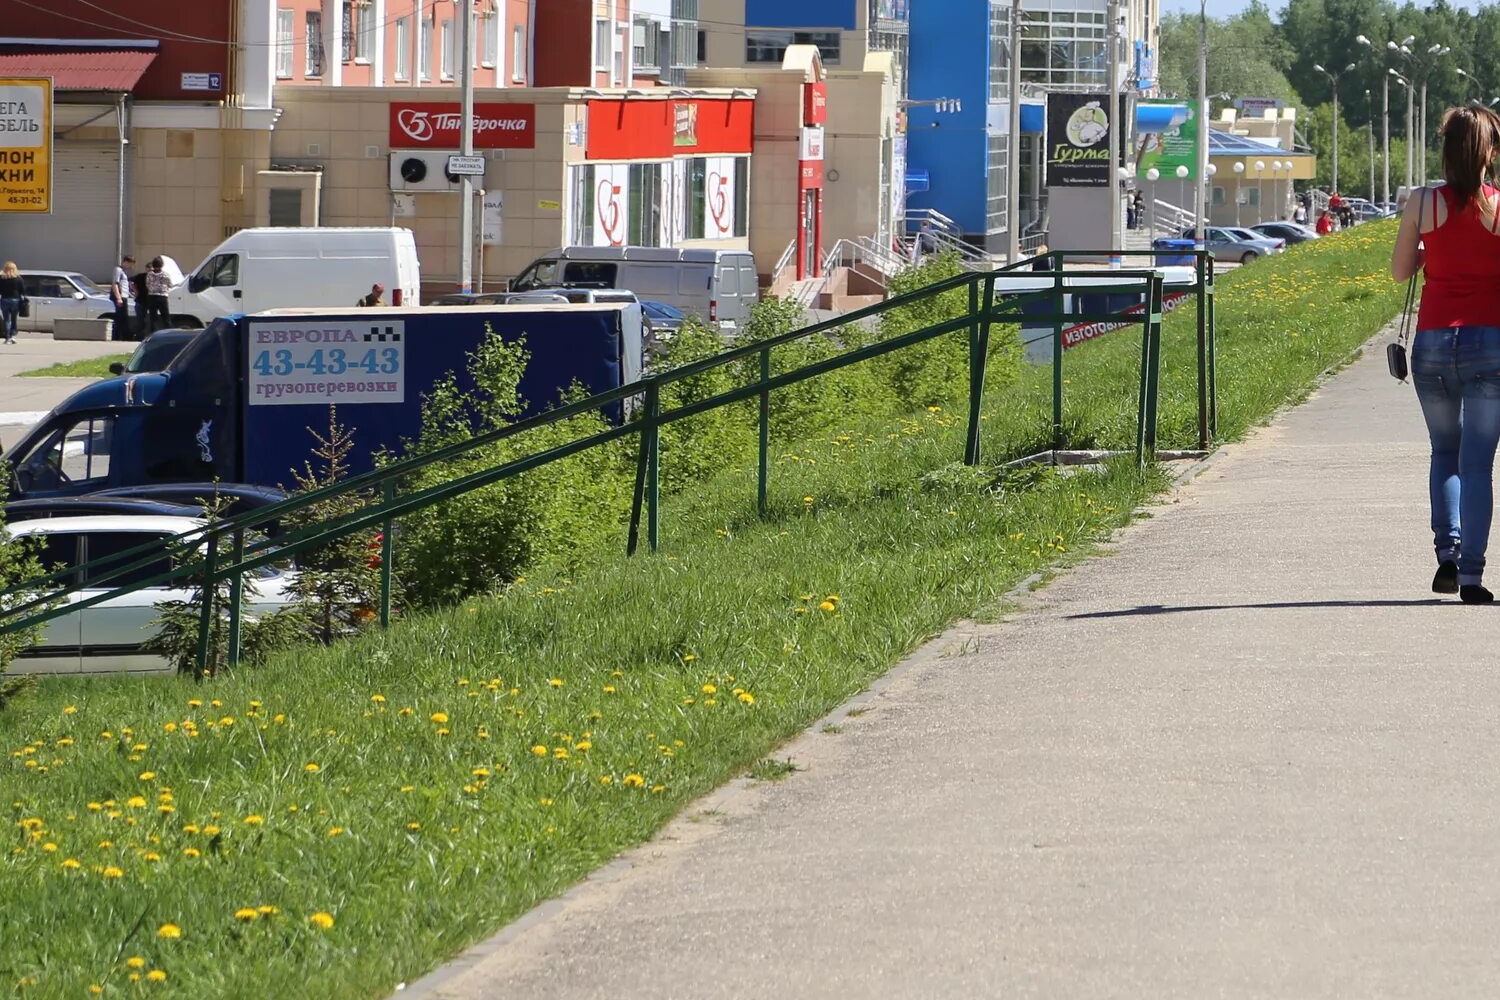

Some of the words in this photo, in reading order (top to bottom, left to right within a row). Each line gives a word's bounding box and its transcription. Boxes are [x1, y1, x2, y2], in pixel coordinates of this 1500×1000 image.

[256, 329, 358, 344] ЕВРОПА
[252, 347, 400, 376] 43-43-43
[256, 381, 398, 398] грузоперевозки
